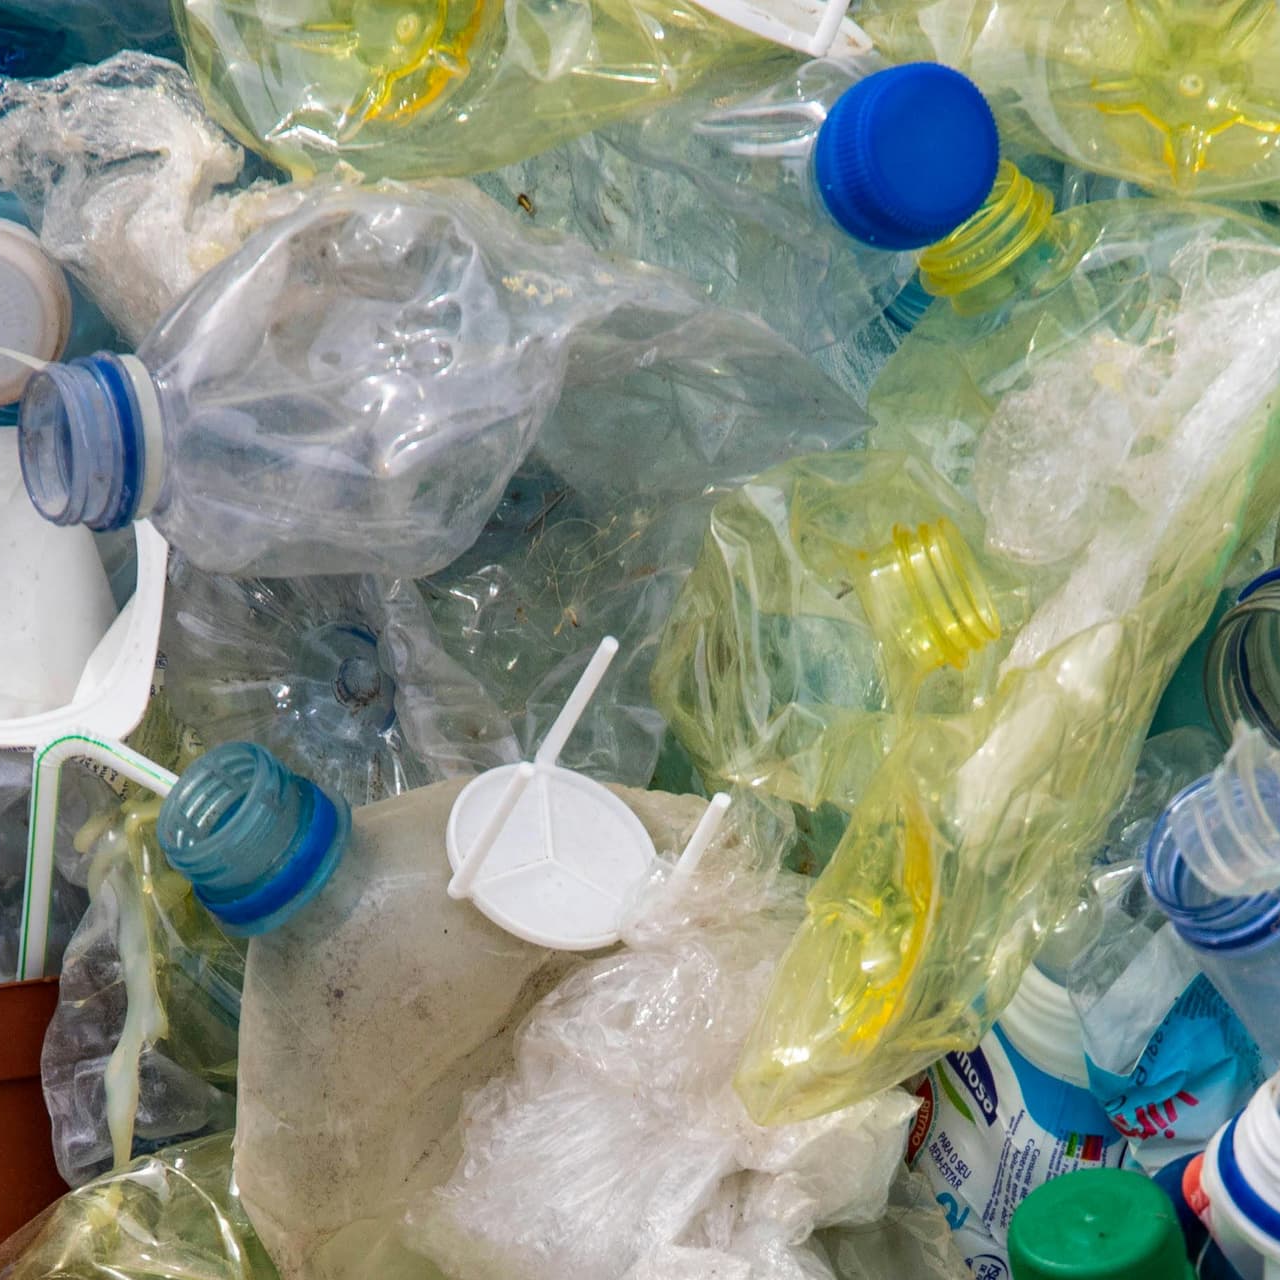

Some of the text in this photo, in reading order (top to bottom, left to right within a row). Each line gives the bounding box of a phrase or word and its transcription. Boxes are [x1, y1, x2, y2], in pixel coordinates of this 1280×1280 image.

[929, 1142, 963, 1190] BEM-ESTAR
[938, 1131, 972, 1179] PARA O SEU
